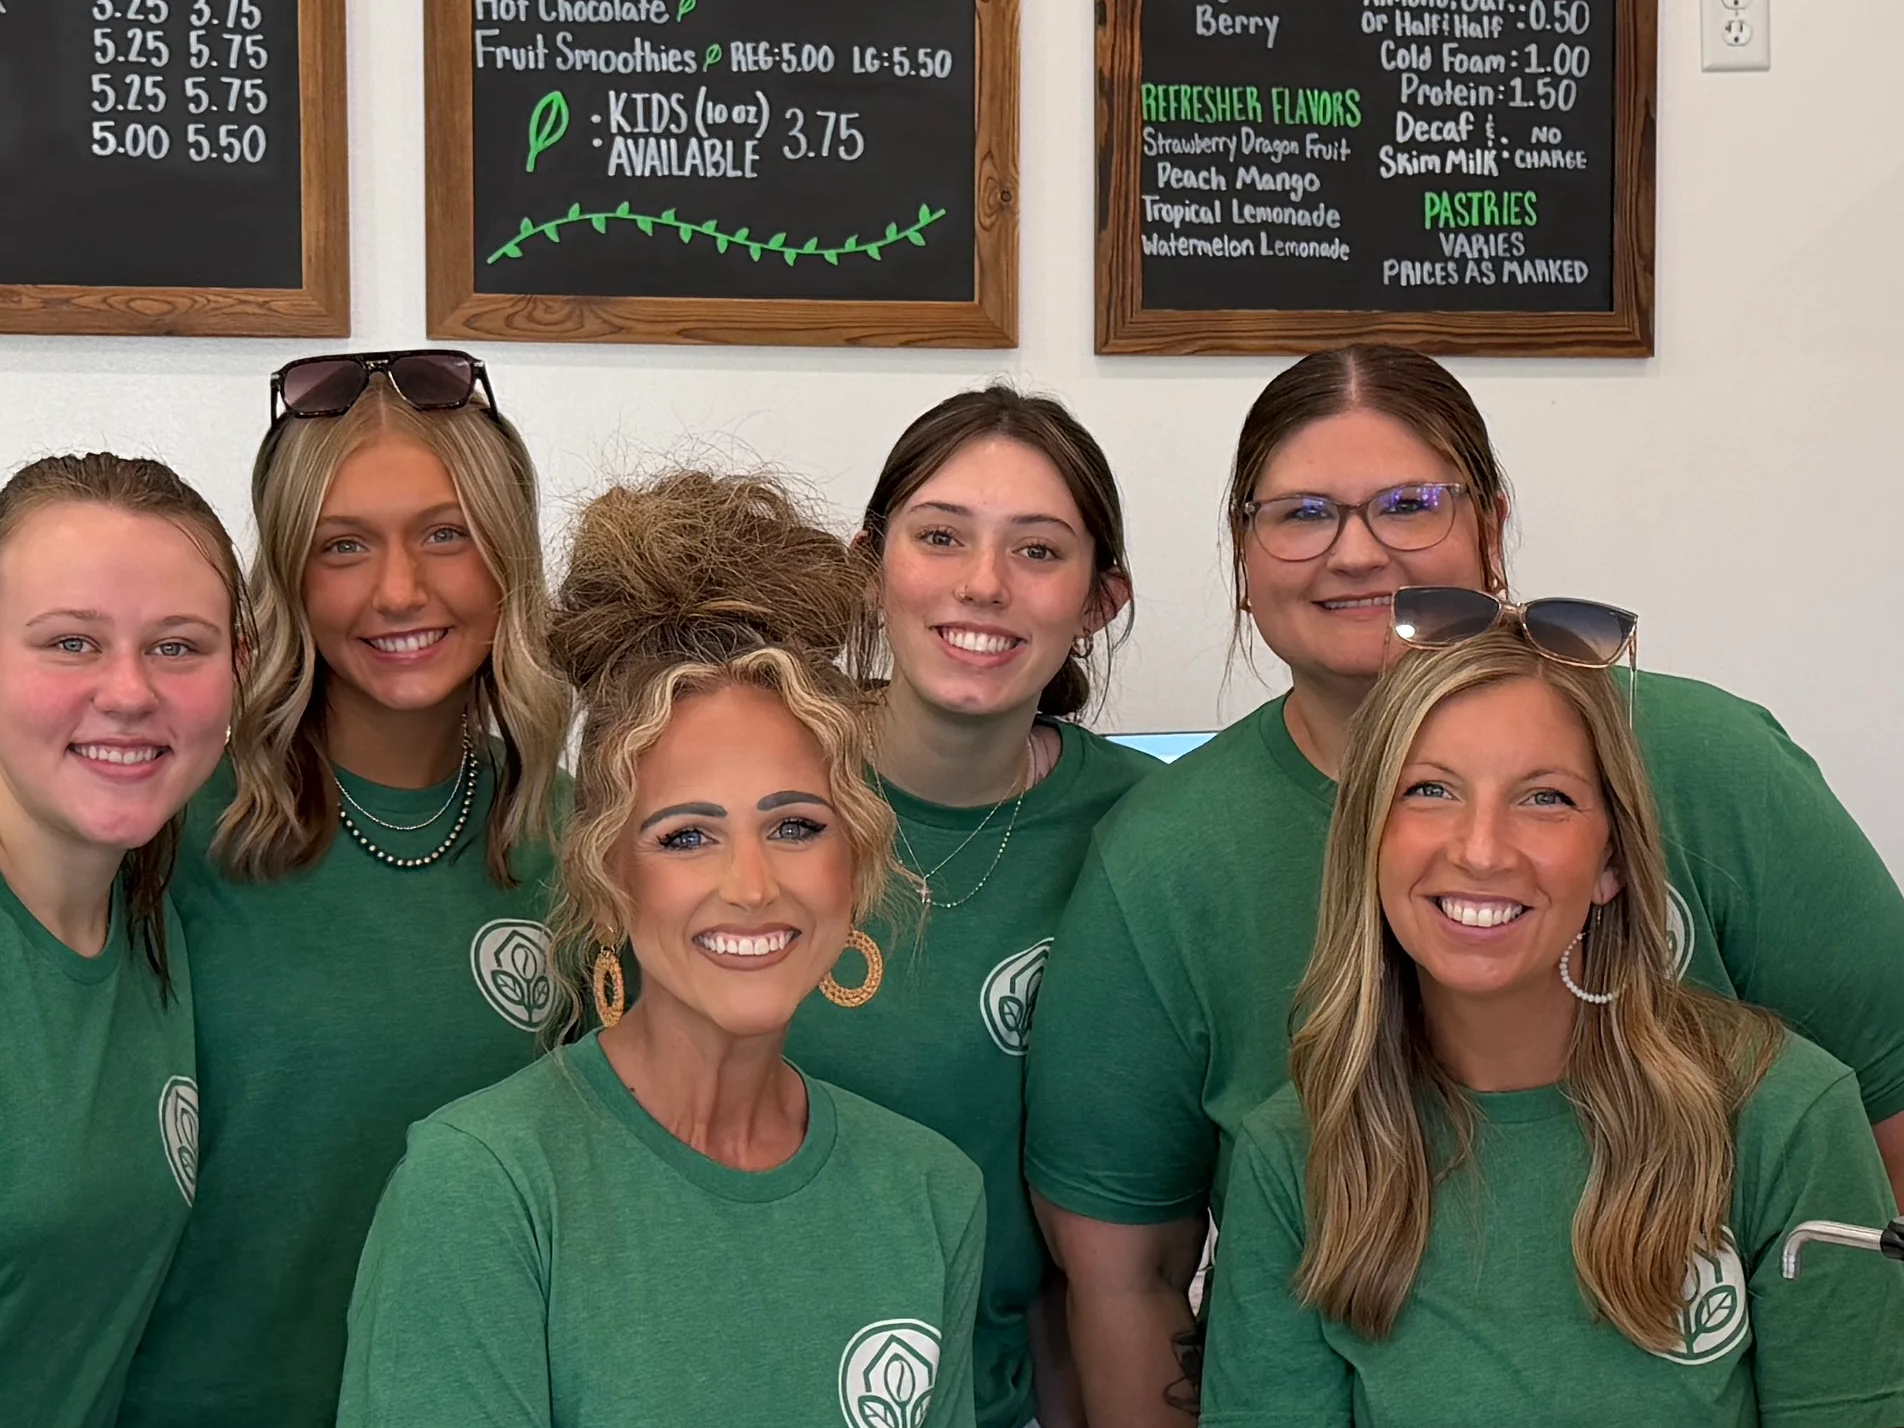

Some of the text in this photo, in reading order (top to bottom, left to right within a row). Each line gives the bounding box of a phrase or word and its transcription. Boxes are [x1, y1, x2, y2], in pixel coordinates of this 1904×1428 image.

[1195, 3, 1280, 49] Berry
[608, 90, 688, 134] KIDS
[782, 107, 864, 161] 3.75
[1140, 82, 1362, 128] REFRESHER FLAVORS
[91, 120, 170, 160] 5.00
[187, 123, 267, 163] 5.50
[607, 135, 760, 179] AVAILABLE
[1157, 161, 1321, 202] Peach Mango
[1424, 190, 1537, 230] PASTRIES
[1439, 231, 1525, 260] VARIES
[1383, 258, 1589, 287] PRICES AS MARKED
